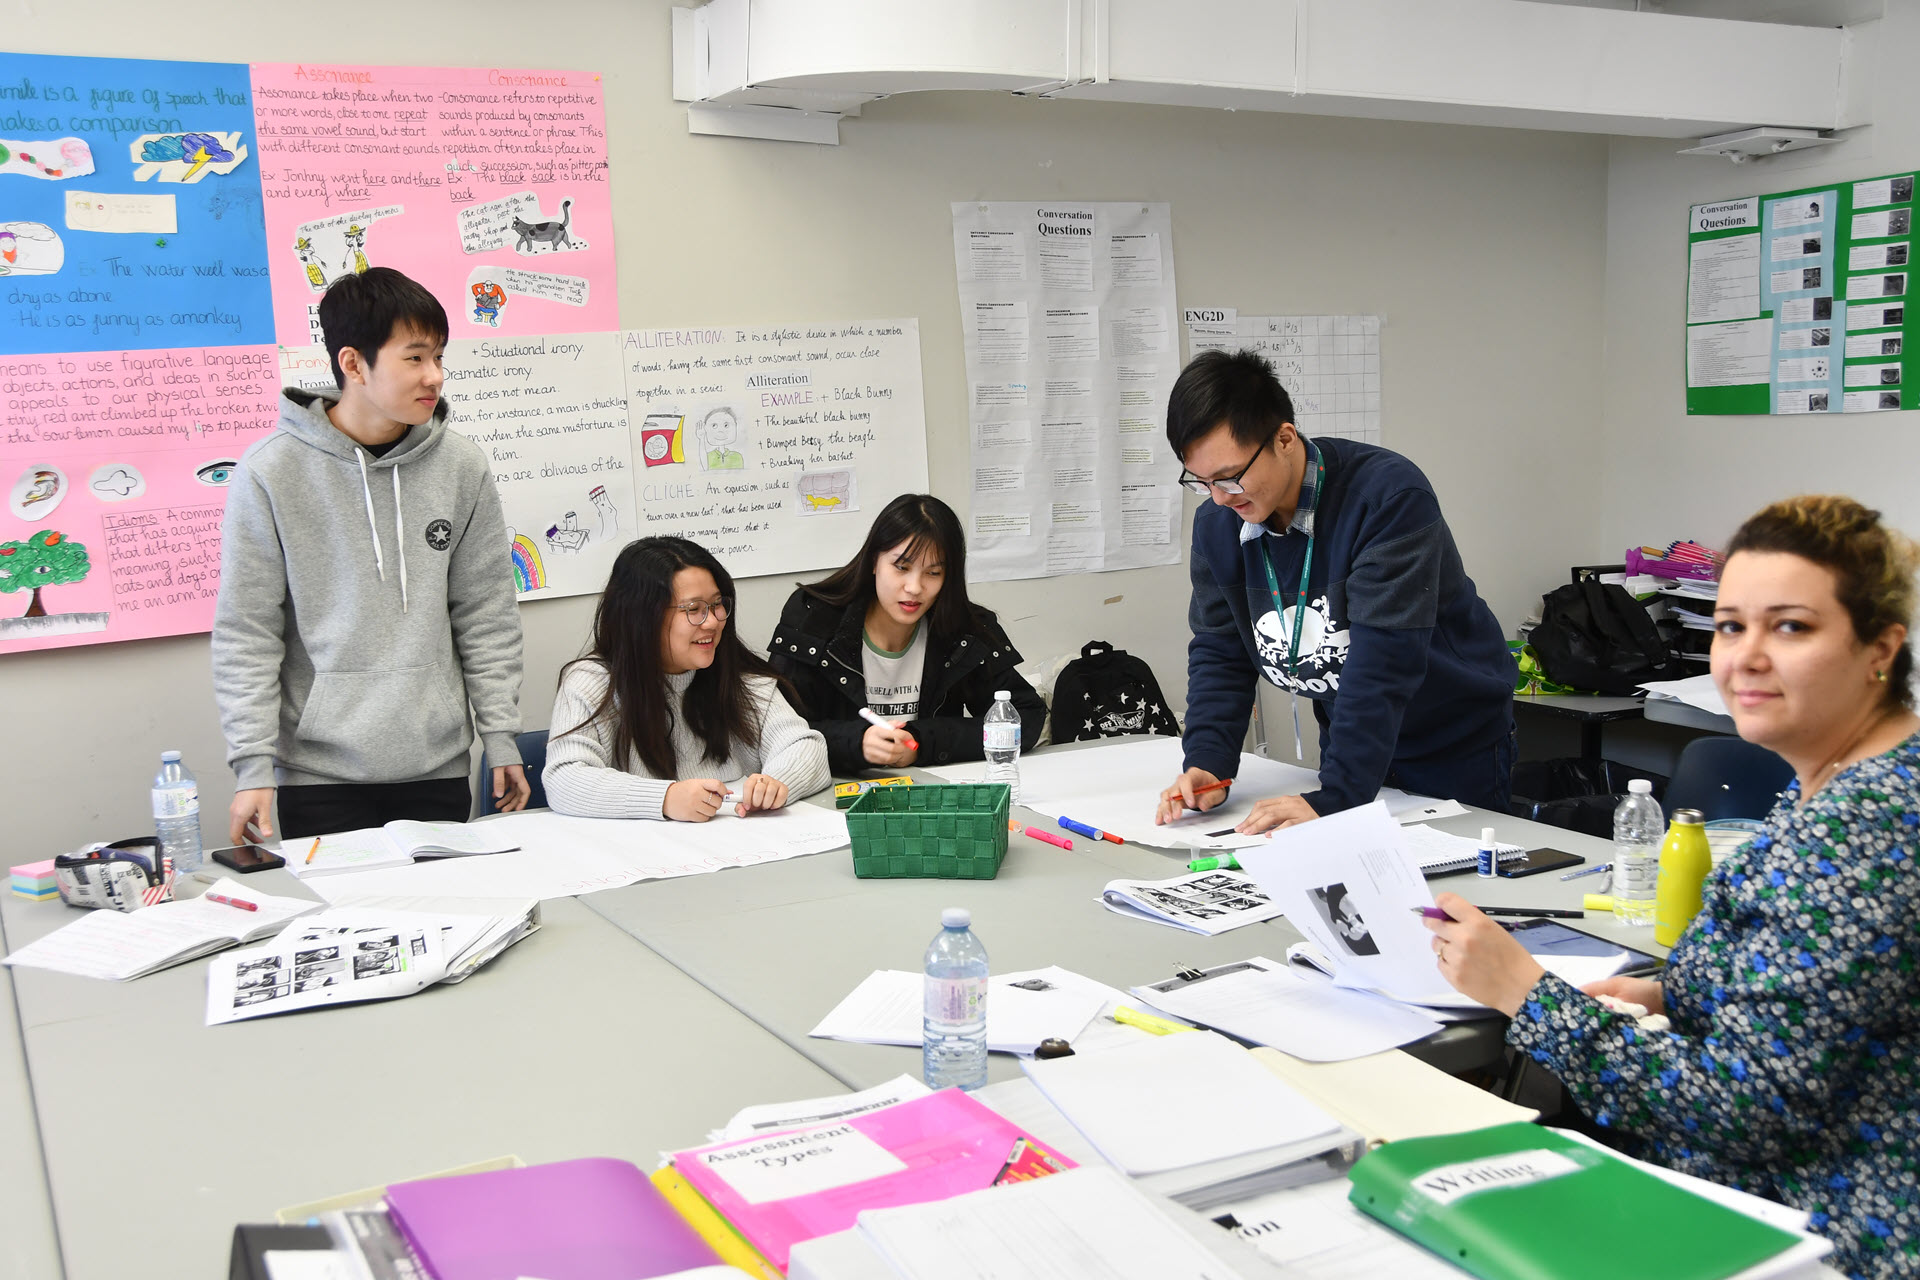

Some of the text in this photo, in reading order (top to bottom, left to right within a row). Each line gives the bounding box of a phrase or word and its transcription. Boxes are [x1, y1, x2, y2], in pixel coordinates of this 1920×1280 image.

[294, 65, 373, 84] Assonance
[488, 69, 568, 87] Consonance
[44, 85, 60, 101] is
[63, 87, 79, 102] a
[90, 86, 136, 113] figure
[211, 87, 247, 106] that
[322, 87, 350, 101] takes
[352, 90, 381, 106] place
[381, 89, 411, 103] when
[413, 93, 433, 103] two
[503, 90, 535, 104] refers
[535, 94, 545, 104] to
[547, 94, 597, 109] repetitive
[48, 117, 63, 132] a
[256, 106, 428, 124] or more words, close to one repeat
[439, 108, 585, 128] sounds produced by consonants
[258, 122, 427, 139] the same vowel sound, but start
[441, 123, 476, 137] within
[480, 127, 488, 137] a
[489, 126, 531, 138] sentence
[533, 127, 544, 137] or
[579, 125, 604, 138] This
[259, 140, 439, 155] with different consonant sounds
[1037, 208, 1093, 221] Conversation
[1700, 202, 1748, 215] Conversation
[1038, 222, 1092, 236] Questions
[1700, 216, 1746, 231] Questions
[104, 255, 132, 277] The
[141, 262, 186, 277] water
[231, 266, 257, 277] was
[1185, 311, 1225, 322] ENG2D
[735, 331, 746, 343] It
[751, 332, 761, 342] is
[771, 328, 801, 346] stylistic
[806, 329, 827, 338] device
[830, 330, 837, 338] in
[840, 326, 864, 338] which
[876, 327, 903, 337] number
[480, 337, 546, 358] Situational
[57, 358, 76, 374] to
[88, 360, 114, 372] use
[121, 352, 194, 377] figurative
[202, 350, 272, 373] language
[280, 351, 332, 375] Irony
[62, 377, 119, 391] actions,
[123, 373, 154, 388] and
[163, 372, 200, 386] ideas
[208, 370, 220, 383] in
[226, 369, 258, 383] such
[262, 369, 275, 380] a
[746, 374, 809, 388] Alliteration
[9, 382, 264, 414] appeals to our physical senses
[451, 392, 470, 402] one
[474, 388, 499, 401] does
[501, 386, 521, 398] not
[834, 387, 862, 401] Black
[866, 386, 893, 400] Bunny
[477, 410, 494, 422] for
[496, 408, 545, 420] instance,
[546, 406, 554, 415] a
[555, 405, 580, 414] man
[581, 402, 591, 411] is
[591, 397, 628, 411] chuckling
[764, 415, 781, 427] The
[823, 410, 847, 422] black
[850, 410, 871, 424] bunny
[766, 437, 797, 451] Bumped
[828, 431, 845, 444] the
[848, 429, 875, 447] beagle
[513, 455, 625, 481] are oblivious of the
[769, 455, 804, 471] Breaking
[809, 452, 823, 462] her
[167, 509, 179, 521] A
[107, 524, 168, 546] that has
[110, 540, 192, 562] that differs
[889, 704, 905, 715] THE
[706, 1125, 856, 1164] Assessment
[754, 1146, 834, 1168] Types
[1423, 1161, 1537, 1195] Writing
